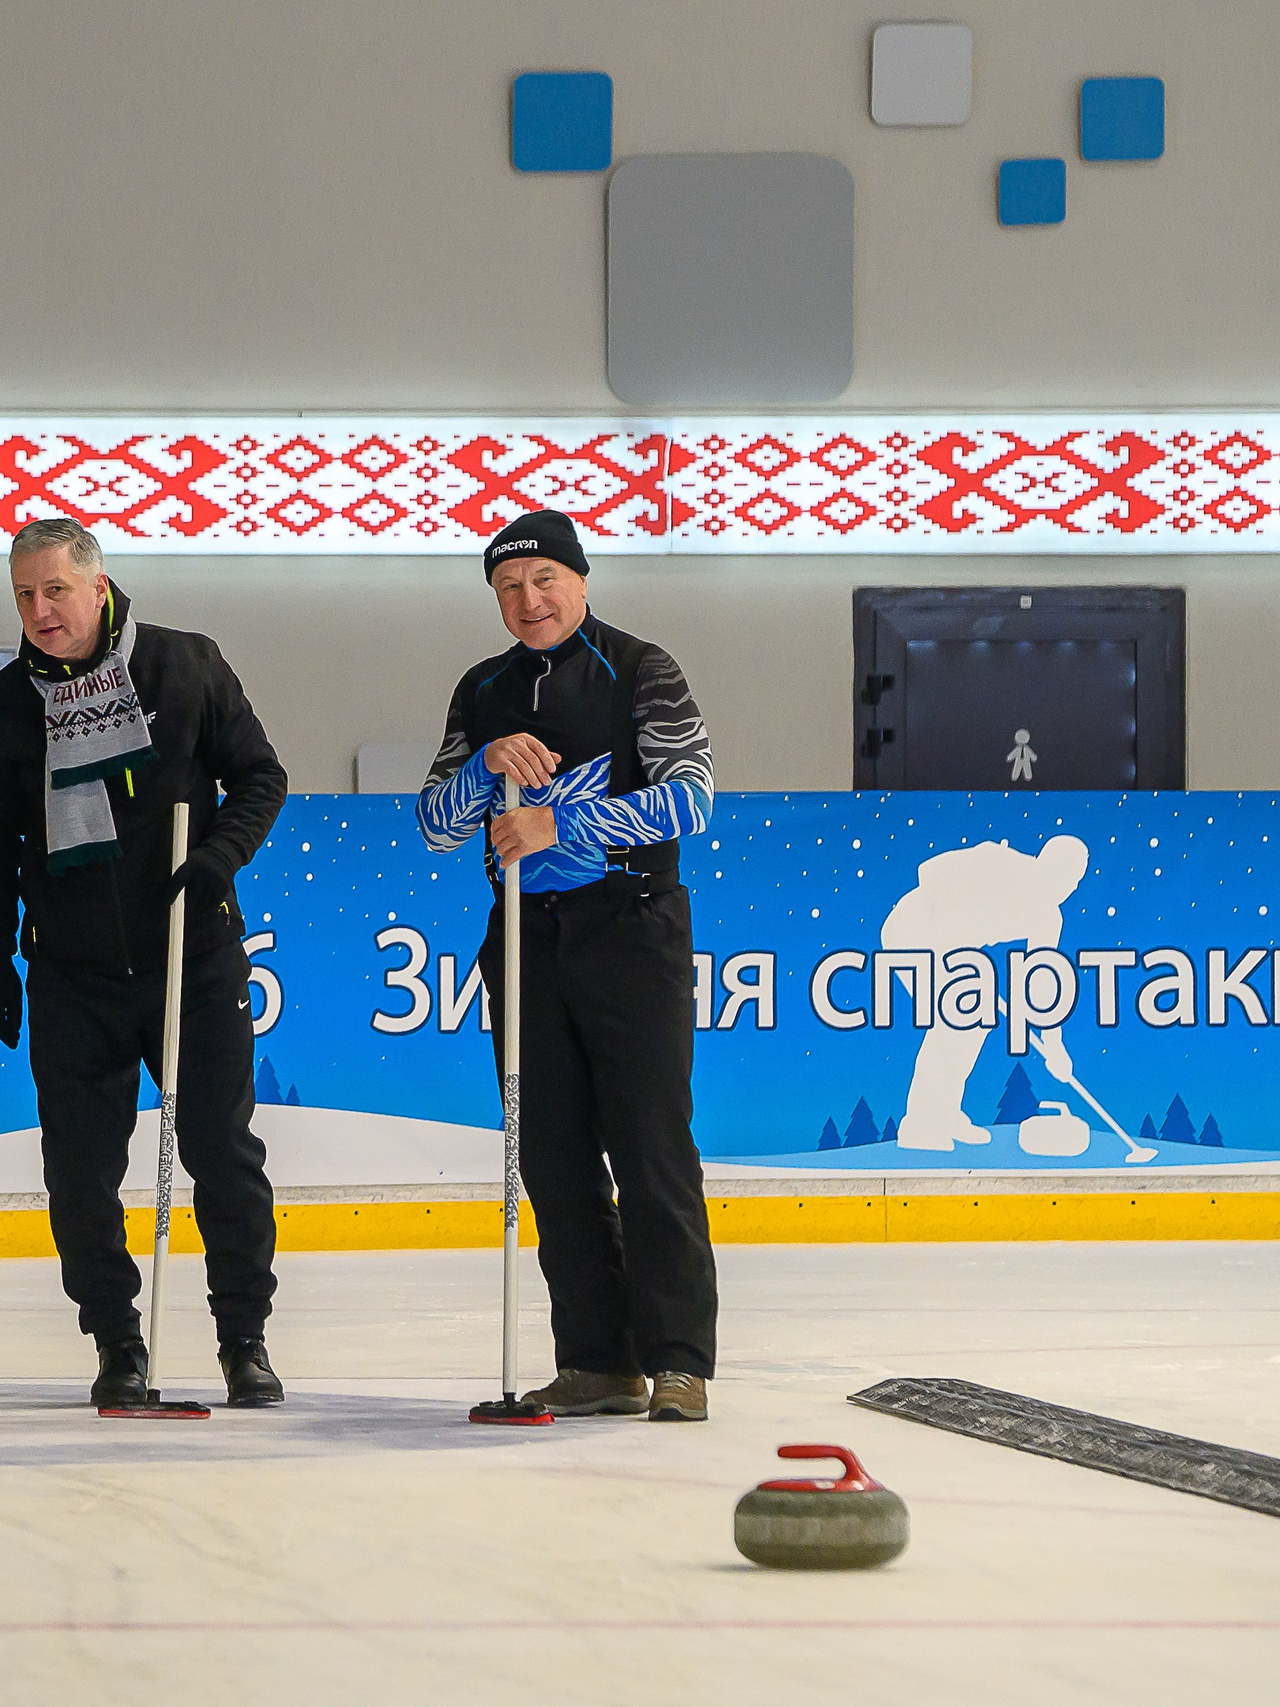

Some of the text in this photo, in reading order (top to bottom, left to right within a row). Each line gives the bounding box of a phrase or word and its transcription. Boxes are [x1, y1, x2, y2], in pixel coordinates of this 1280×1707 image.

[491, 539, 538, 559] macron
[53, 666, 125, 705] ЕДИНЫЕ
[809, 947, 1280, 1056] спартак
